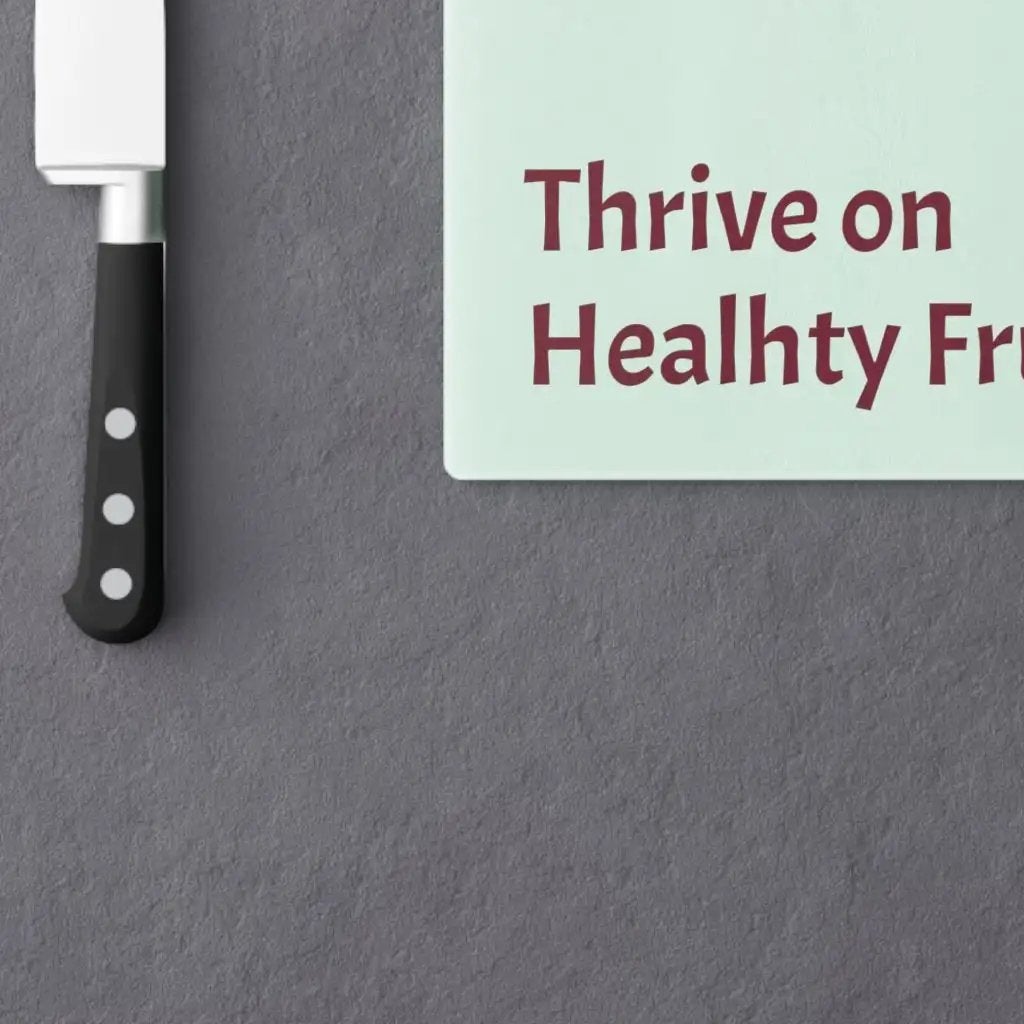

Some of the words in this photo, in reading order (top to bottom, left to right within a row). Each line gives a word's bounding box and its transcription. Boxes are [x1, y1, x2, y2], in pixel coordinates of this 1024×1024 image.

[523, 160, 818, 253] Thrive
[841, 190, 953, 253] on
[531, 293, 902, 411] Healhty
